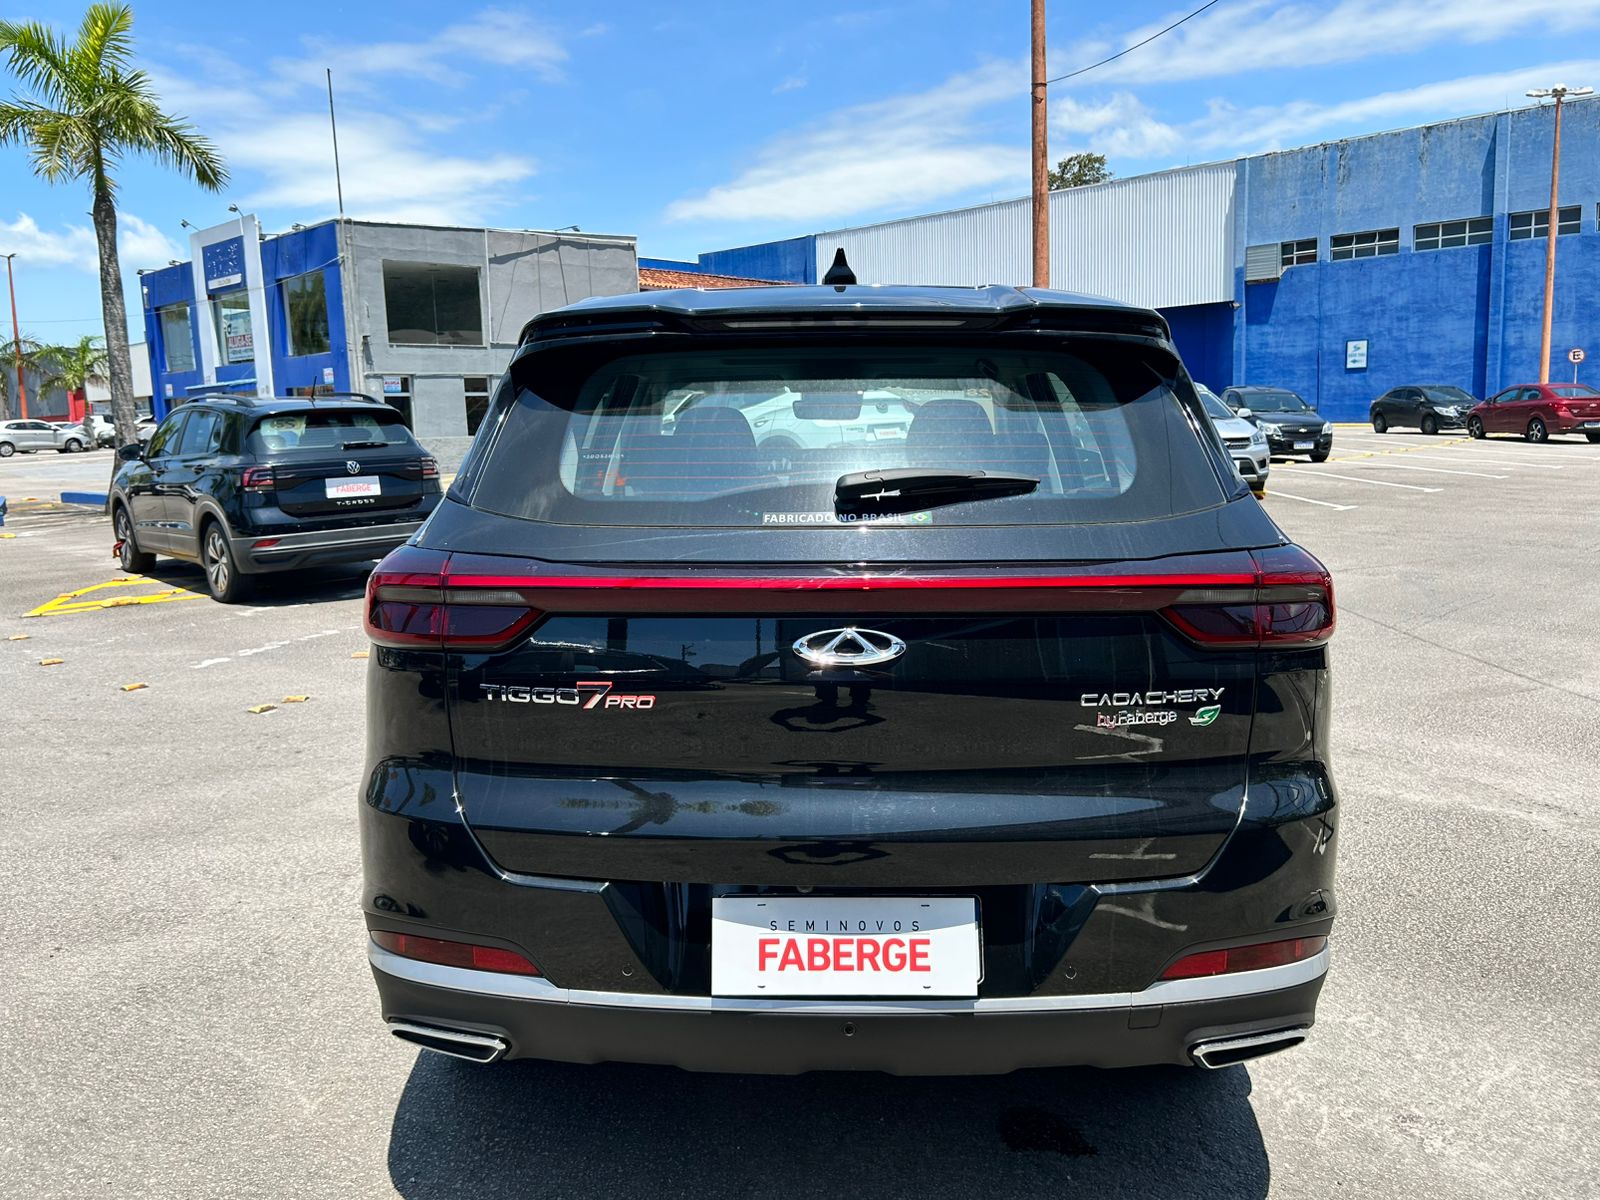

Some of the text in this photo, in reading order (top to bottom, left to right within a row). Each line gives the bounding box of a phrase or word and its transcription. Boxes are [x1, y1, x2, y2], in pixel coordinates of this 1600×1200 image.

[1572, 350, 1582, 361] E
[336, 483, 373, 493] FABERGE
[336, 498, 375, 506] T-CROSS
[764, 512, 906, 524] FABRICADO NO BRASIL
[604, 694, 656, 710] PRO
[1146, 687, 1225, 705] CHERY
[1096, 709, 1178, 730] by Faberge
[770, 920, 920, 932] SEMINOVOS
[758, 938, 931, 972] FABERGE
